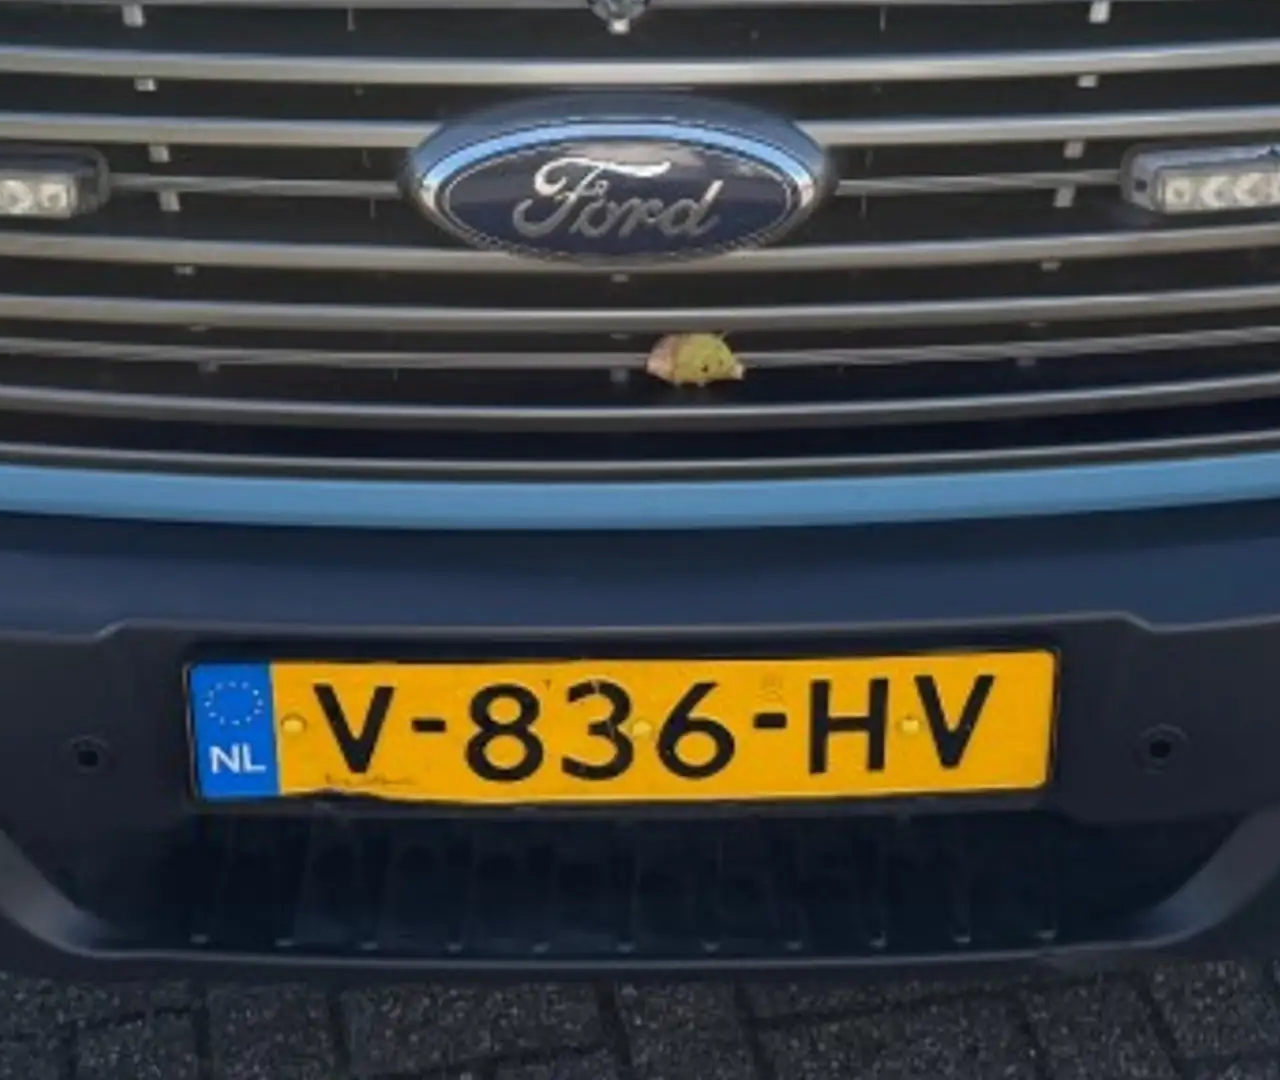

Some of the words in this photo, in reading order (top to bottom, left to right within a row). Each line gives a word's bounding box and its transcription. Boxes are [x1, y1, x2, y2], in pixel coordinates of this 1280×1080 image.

[512, 156, 724, 238] Ford
[209, 742, 266, 775] NL
[313, 674, 995, 782] V-836-HV
